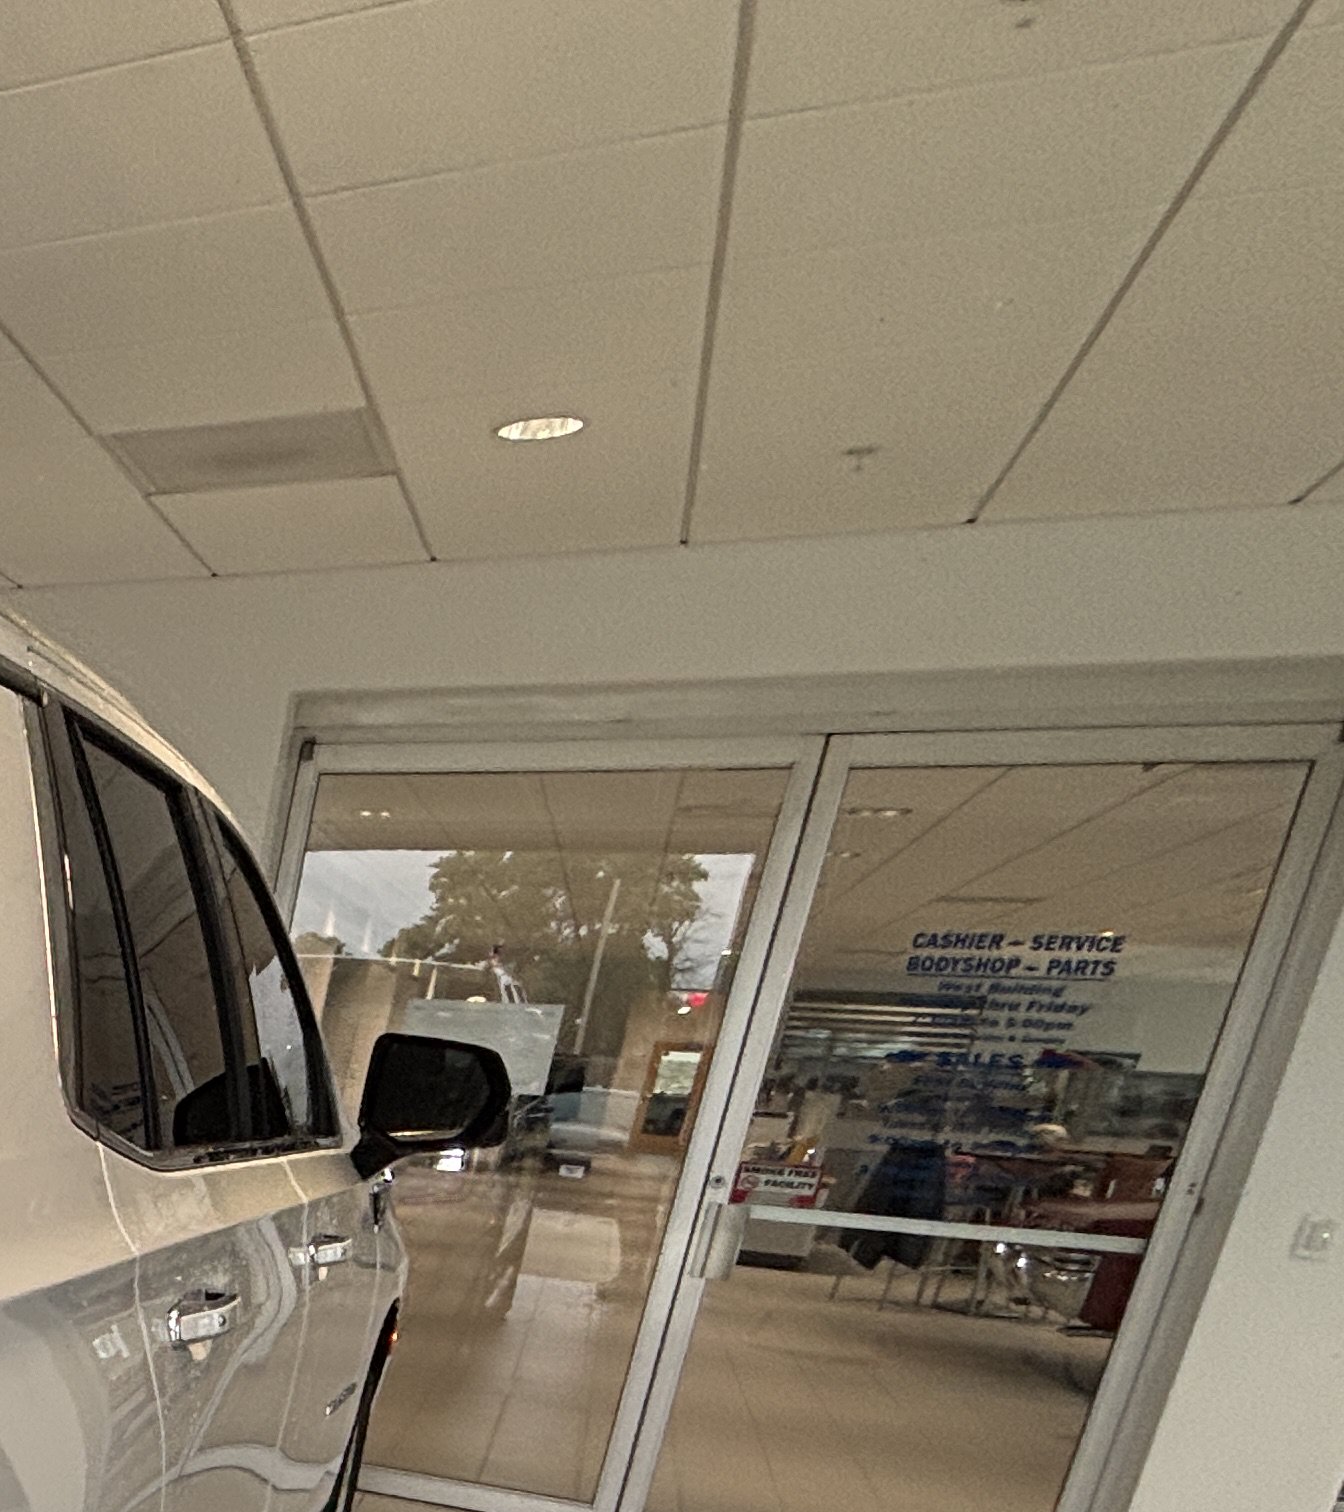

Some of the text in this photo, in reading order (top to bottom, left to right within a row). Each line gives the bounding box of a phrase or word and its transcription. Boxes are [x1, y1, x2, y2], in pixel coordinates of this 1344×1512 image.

[913, 932, 1005, 950] CASHIER
[1030, 934, 1126, 953] SERVICE
[906, 955, 1021, 974] BODYSHOP
[1046, 958, 1117, 976] PARTS
[988, 982, 1067, 998] Building
[1026, 1001, 1092, 1017] Friday
